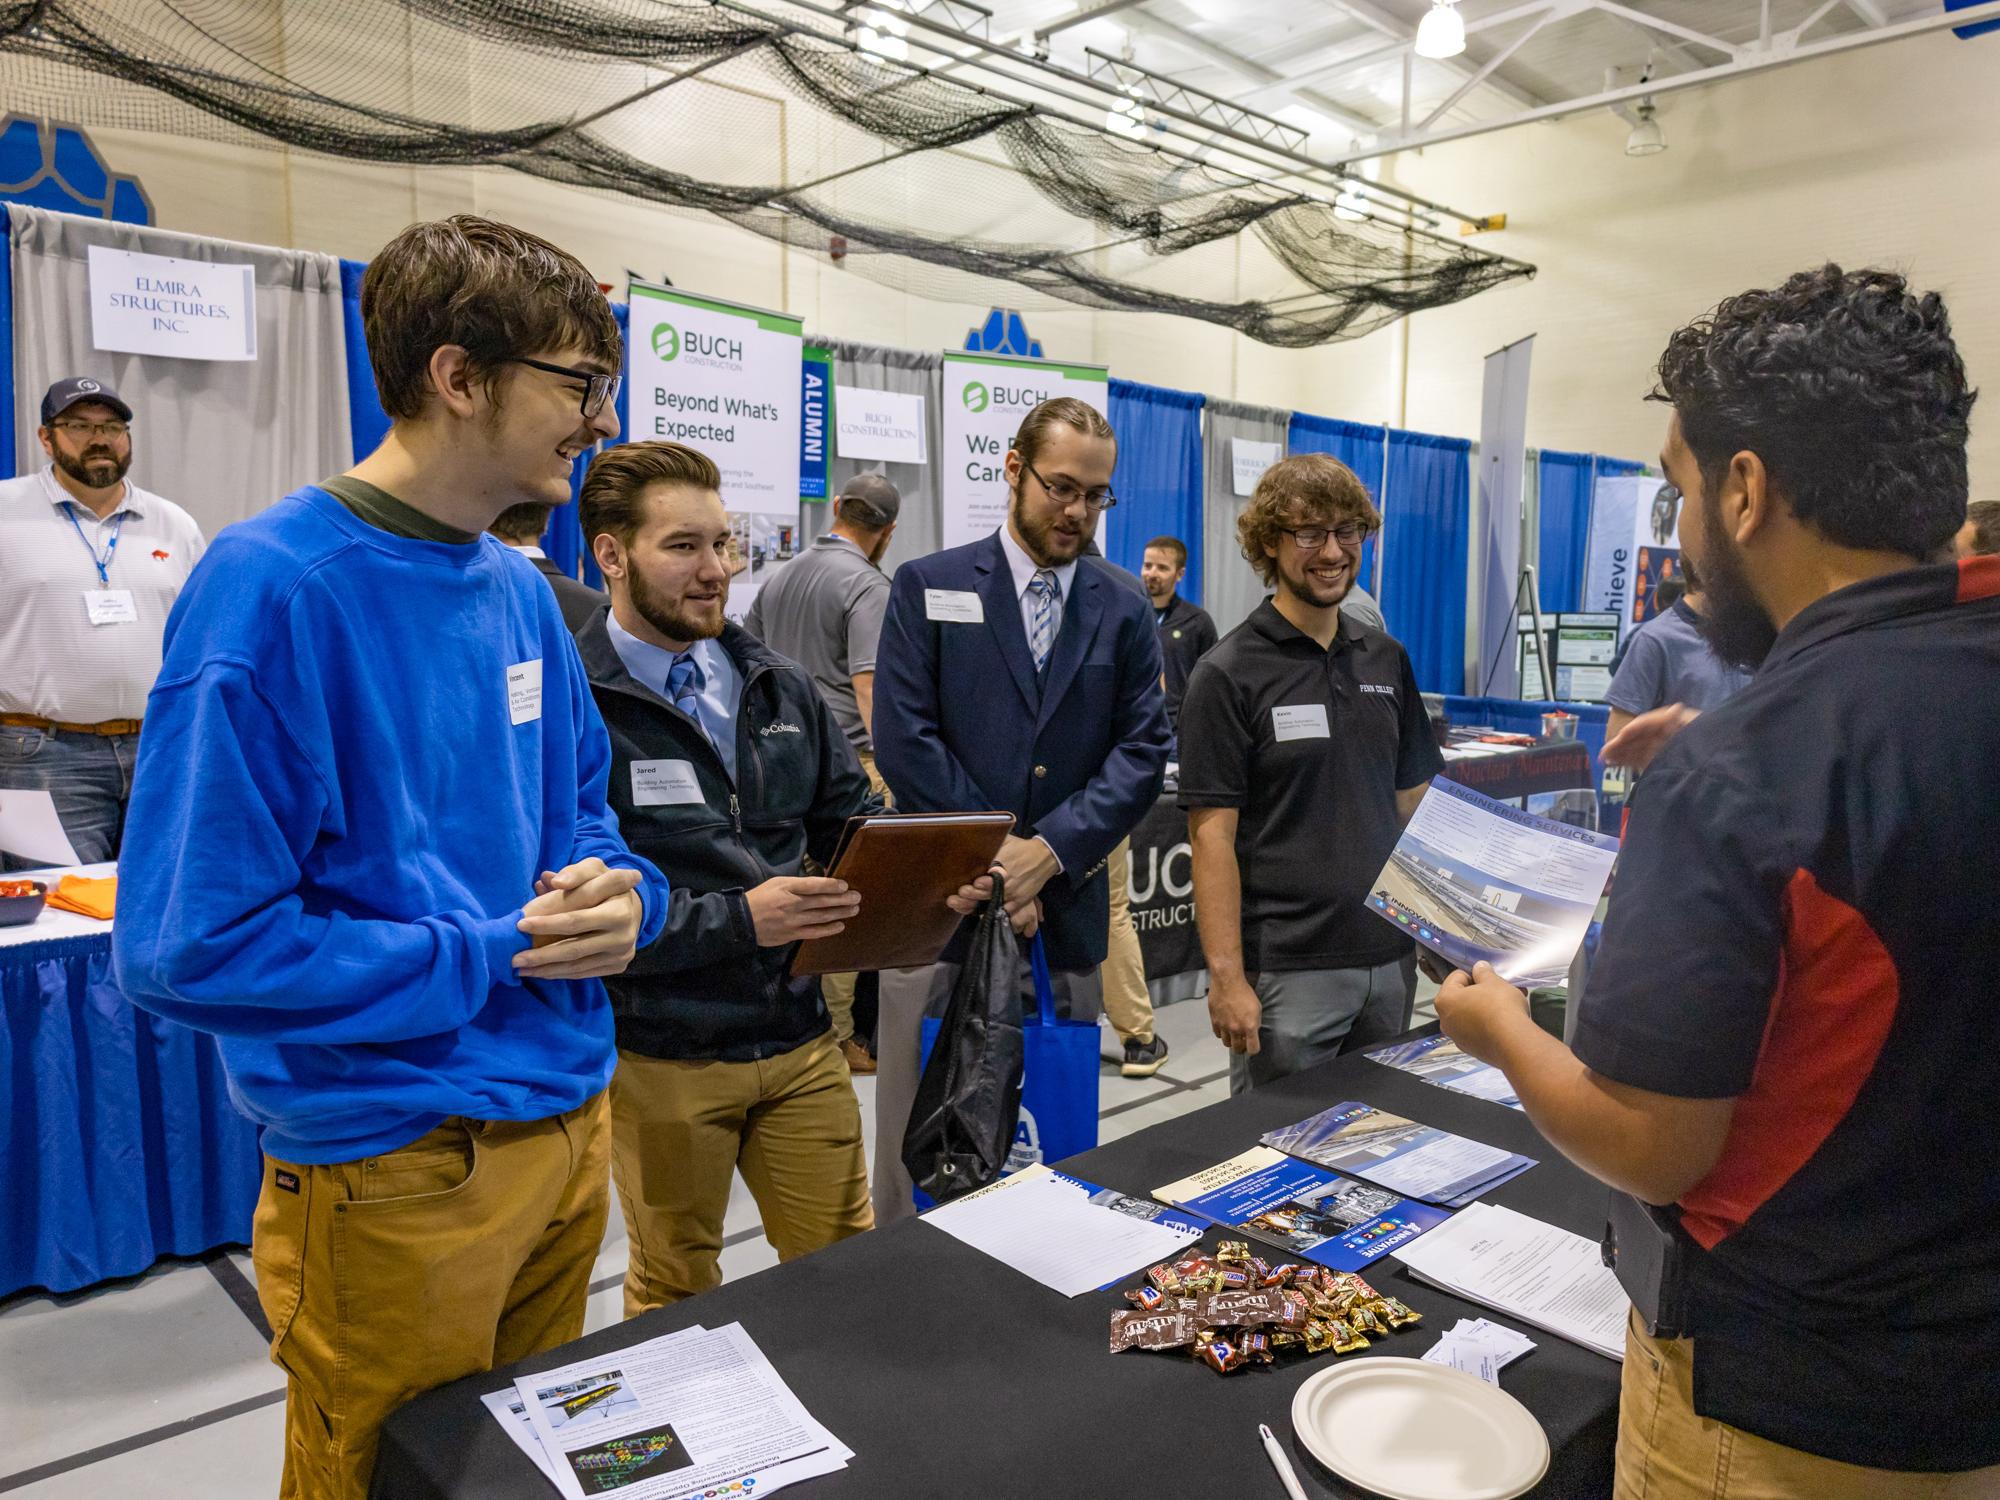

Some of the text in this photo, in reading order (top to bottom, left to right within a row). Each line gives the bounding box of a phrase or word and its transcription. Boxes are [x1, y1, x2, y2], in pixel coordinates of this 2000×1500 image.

[136, 277, 202, 297] ELMIRA
[110, 293, 230, 320] STRUCTURES,
[153, 317, 189, 334] INC.
[685, 331, 742, 361] BUCH
[684, 355, 743, 371] CONSTRUCTION
[655, 387, 778, 421] Beyond What's
[993, 386, 1048, 406] BUCH
[805, 373, 822, 461] ALUMNI
[865, 412, 892, 424] BUCH
[655, 416, 735, 443] Expected
[841, 423, 916, 440] CONSTRUCTION
[966, 434, 1000, 455] We
[966, 462, 1006, 482] Car
[1605, 548, 1628, 612] hieve
[1360, 684, 1375, 692] PENN
[1448, 785, 1533, 825] ENGINEERING
[1535, 821, 1596, 843] SERVICES
[1126, 842, 1194, 903] UC
[1131, 902, 1197, 932] STRUCT
[1246, 1181, 1322, 1217] ESTAMOS CONTRATANDO
[1361, 1230, 1412, 1258] INNOVATIVE
[738, 1456, 780, 1472] Mechanical
[692, 1469, 736, 1486] Engineering
[639, 1484, 690, 1500] Opportuniti
